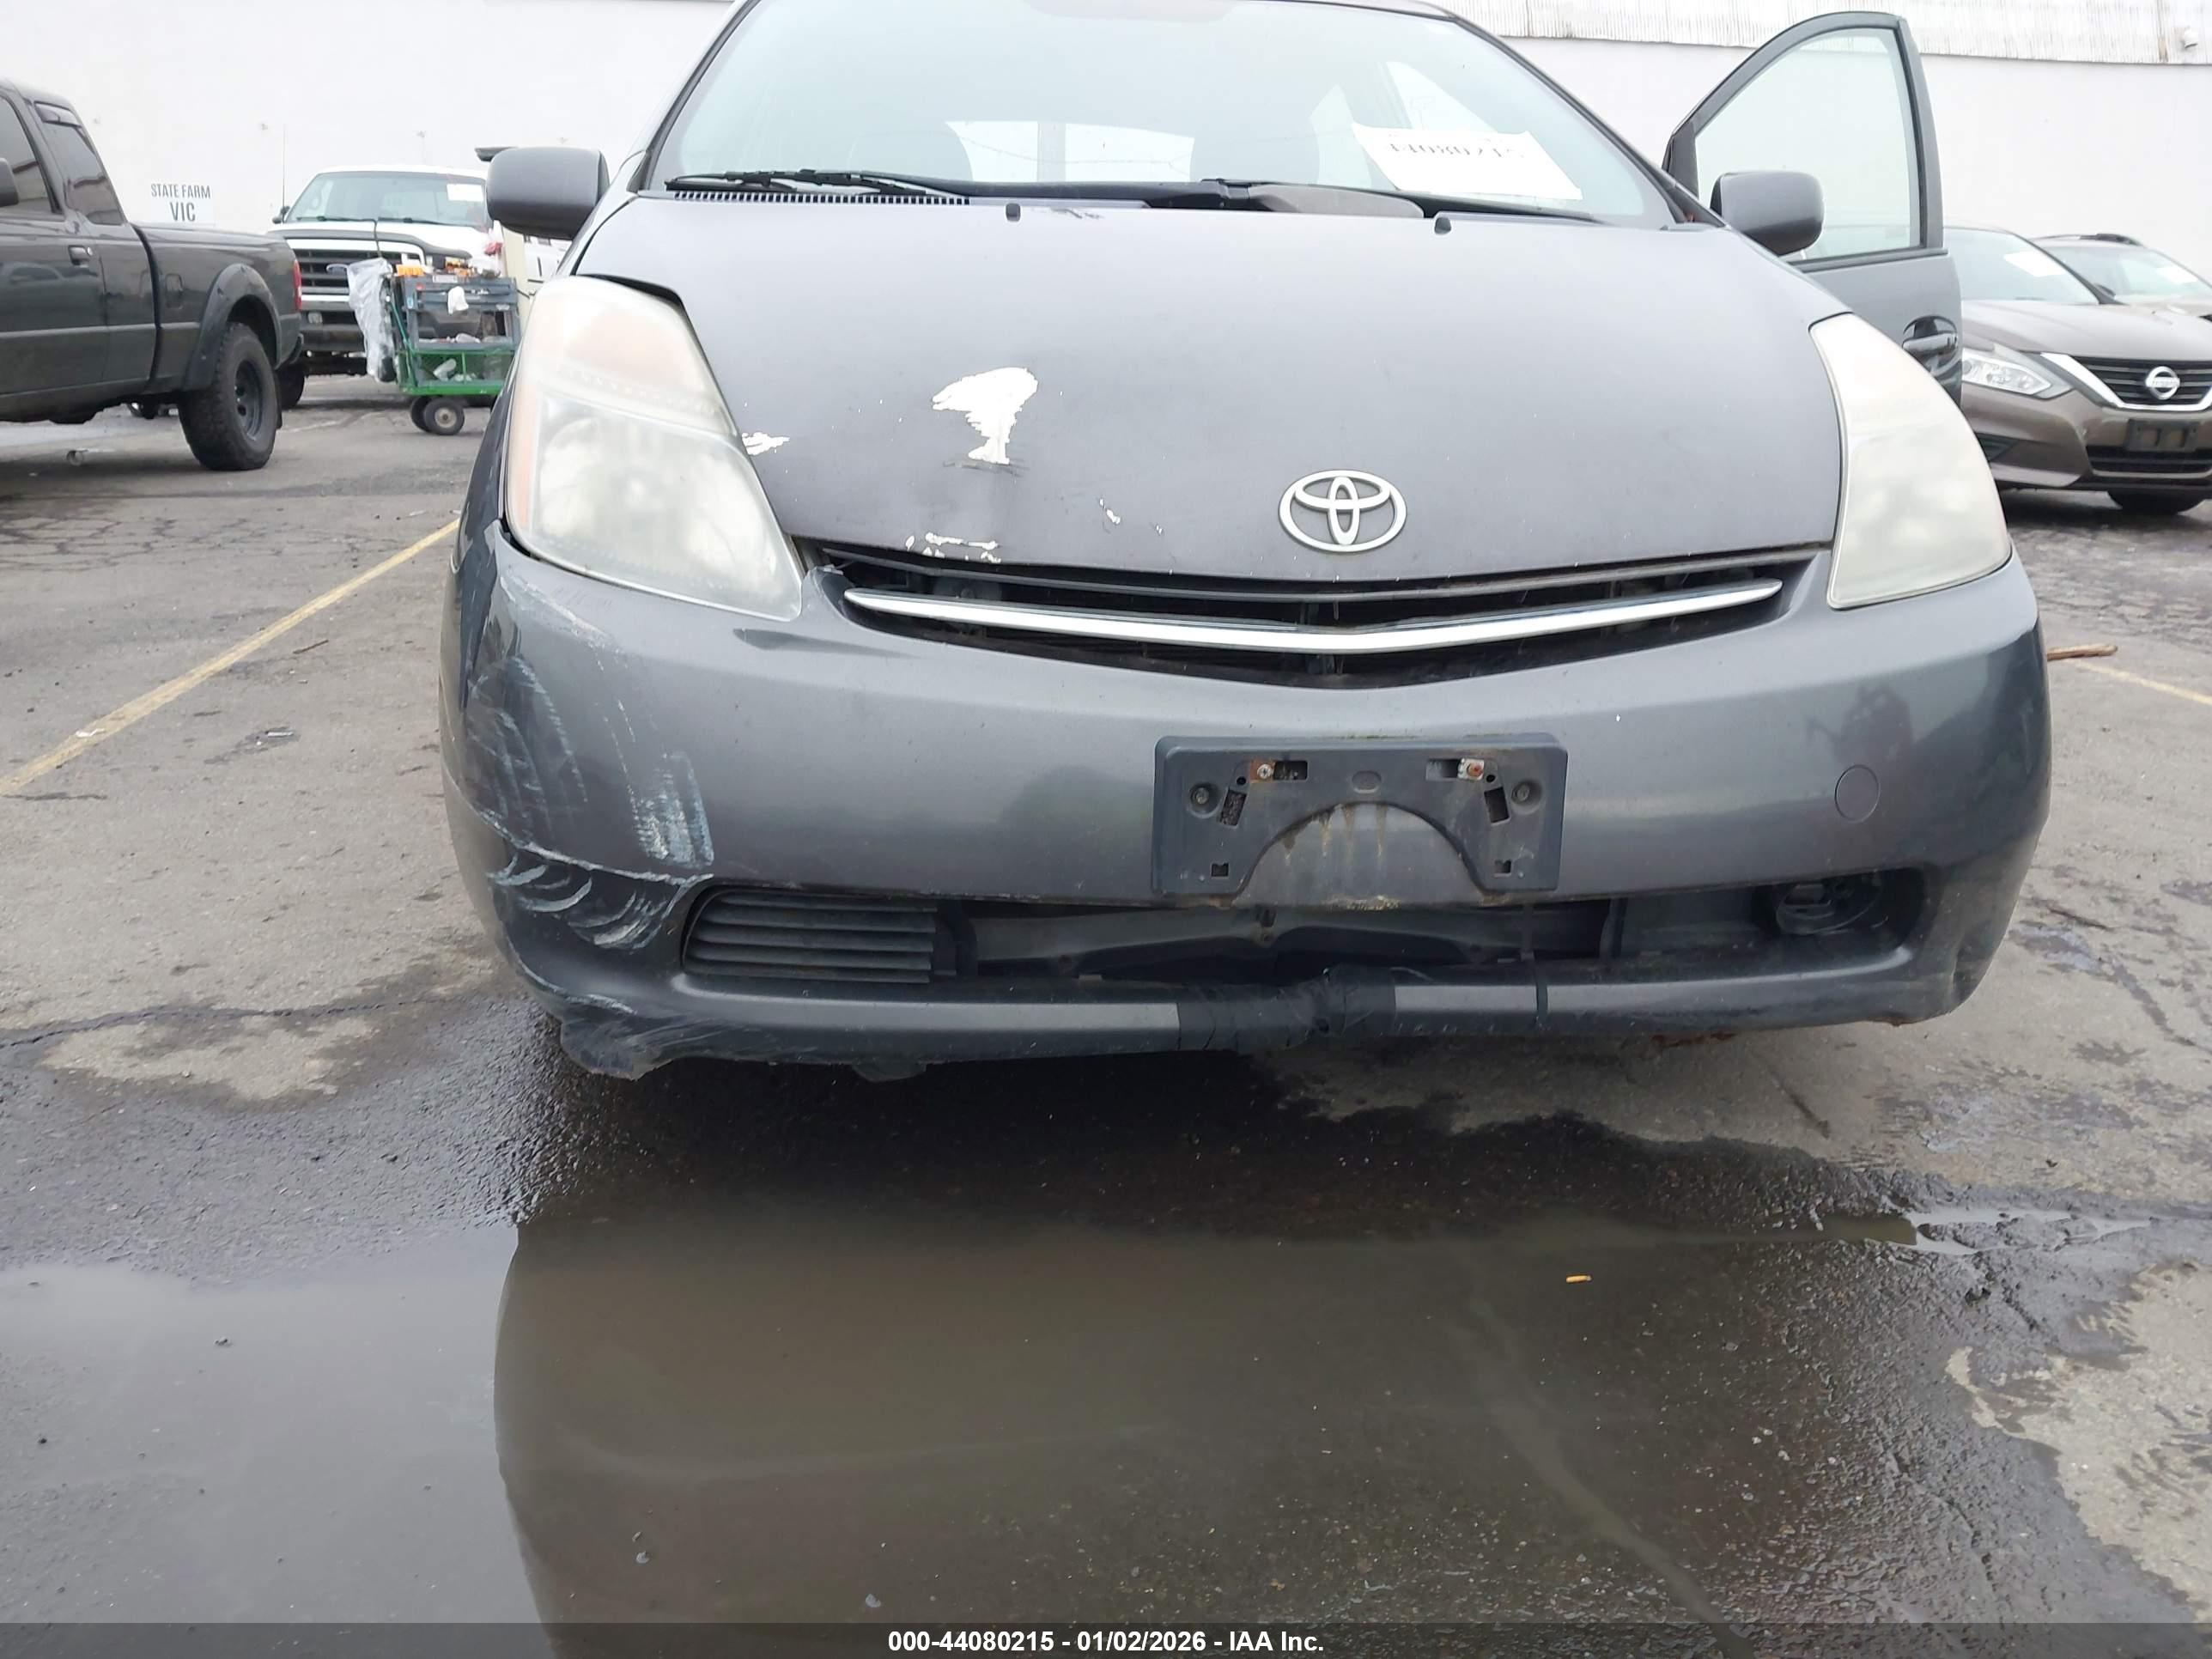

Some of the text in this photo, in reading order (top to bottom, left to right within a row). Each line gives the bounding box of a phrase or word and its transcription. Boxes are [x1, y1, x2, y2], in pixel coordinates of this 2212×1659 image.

[150, 184, 210, 198] STATE FARM
[170, 202, 196, 222] VIC
